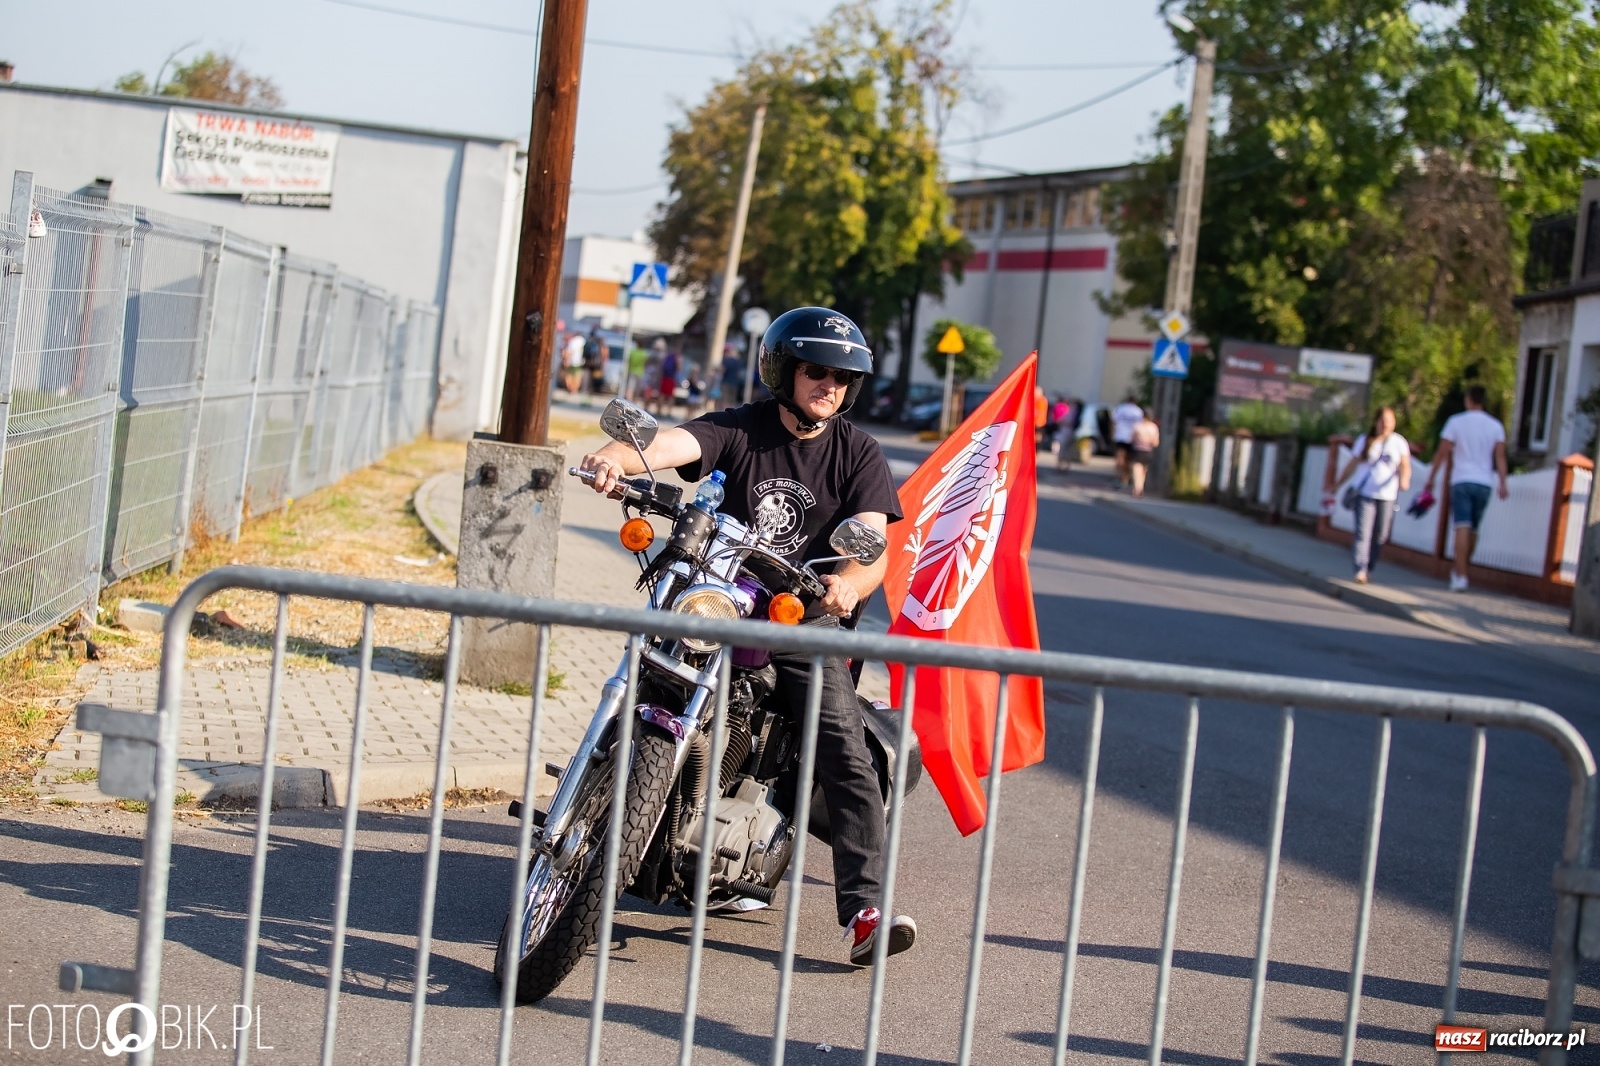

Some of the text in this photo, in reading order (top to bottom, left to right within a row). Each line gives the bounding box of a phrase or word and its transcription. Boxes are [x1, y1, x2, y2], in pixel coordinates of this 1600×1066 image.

[196, 113, 315, 142] TRWA NABÓR
[175, 129, 329, 160] Sekcja Podnoszenia
[758, 481, 773, 493] SRC
